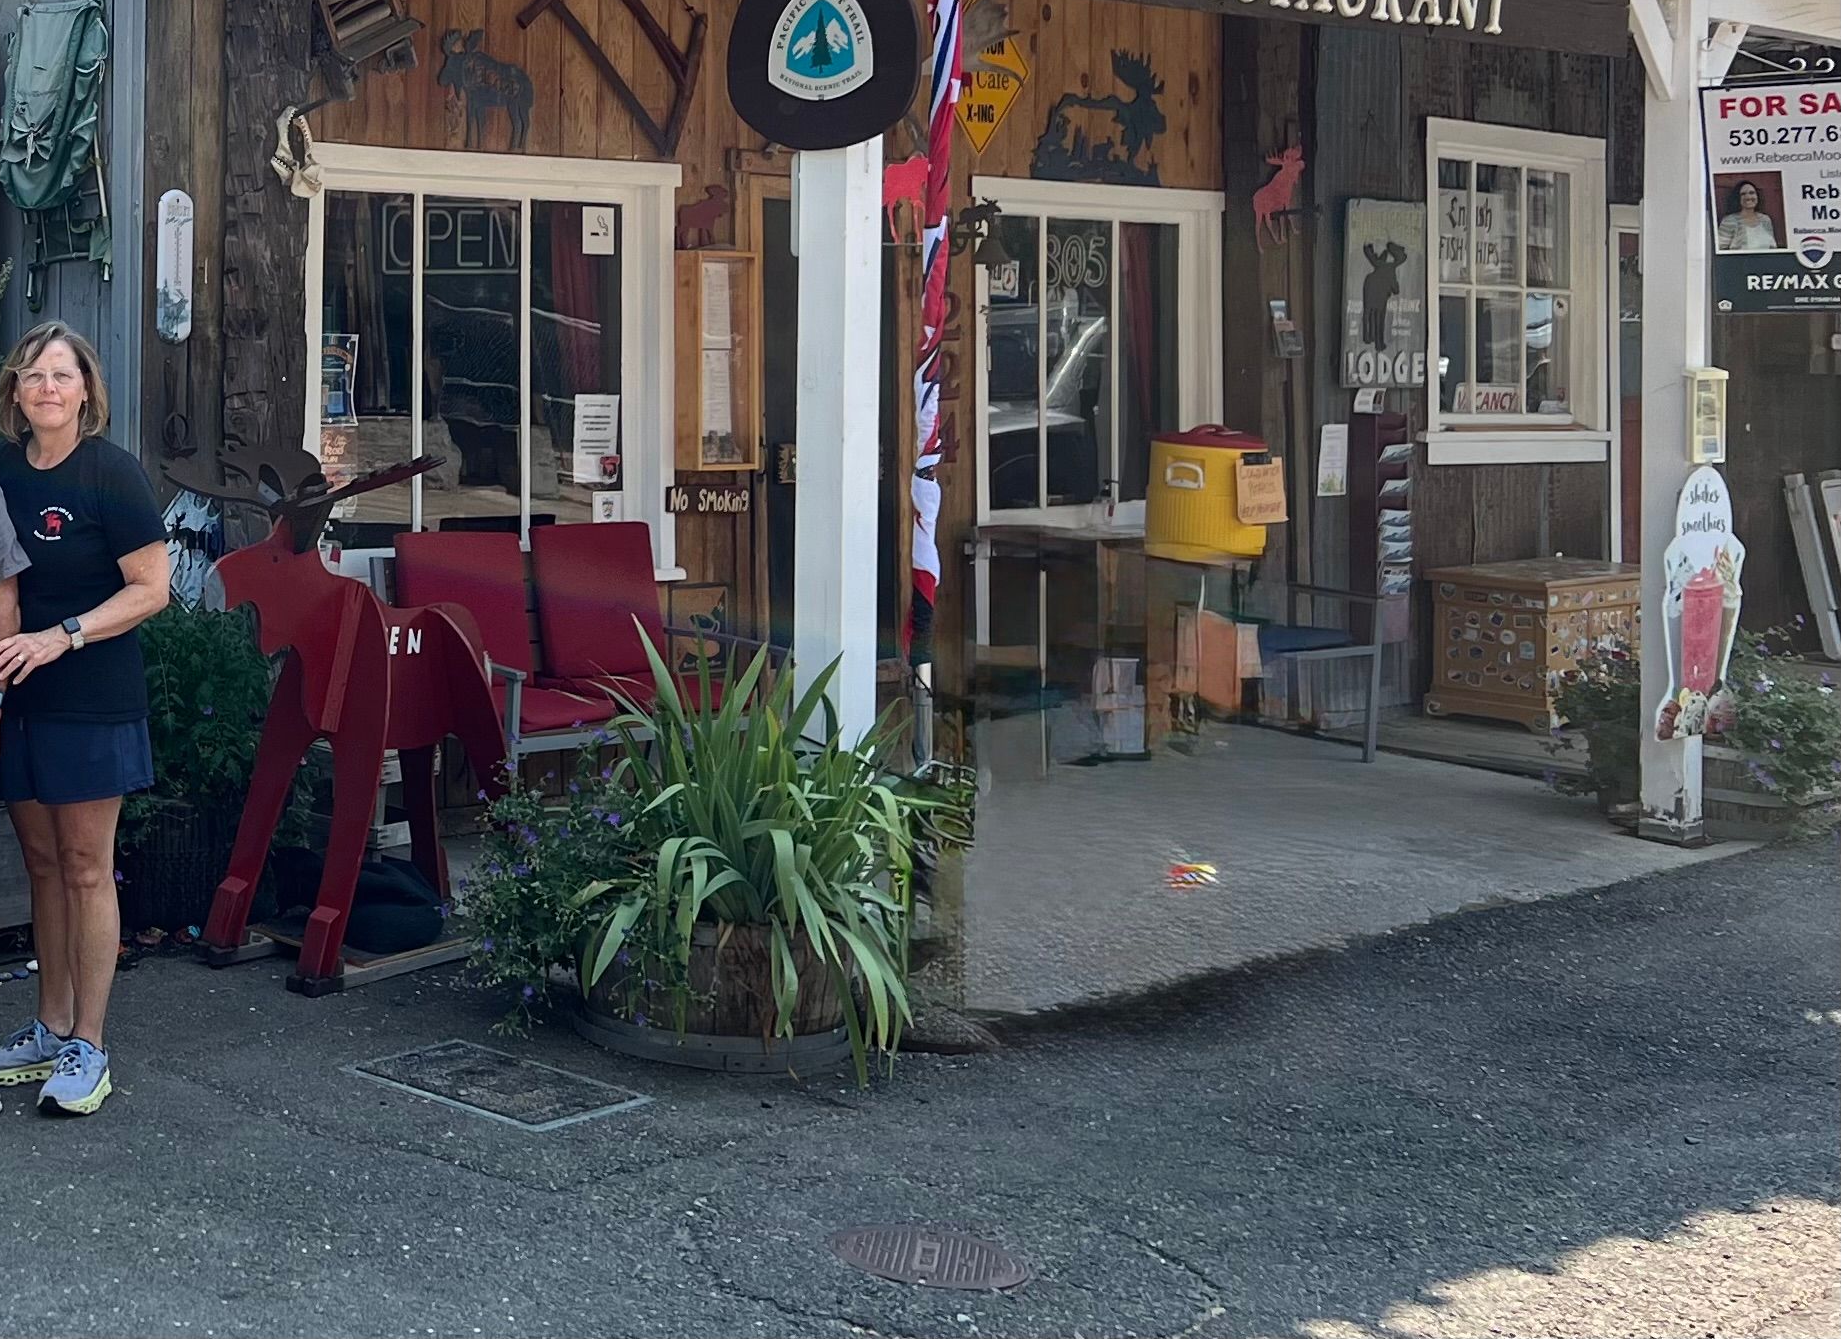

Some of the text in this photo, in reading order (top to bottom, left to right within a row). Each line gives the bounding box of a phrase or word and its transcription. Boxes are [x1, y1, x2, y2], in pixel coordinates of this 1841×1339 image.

[844, 4, 865, 45] TRAIL
[779, 70, 863, 91] NATIONAL SCENIC TRAIL
[966, 103, 995, 123] X-ING
[1719, 94, 1788, 119] FOR
[1729, 125, 1841, 147] 530.277.6
[389, 209, 517, 268] OPEN
[1747, 273, 1830, 291] RE/MAX
[1345, 350, 1425, 384] LODGE
[1457, 391, 1516, 411] VCANCY
[670, 487, 689, 513] No
[1689, 483, 1720, 505] shakes
[1681, 511, 1726, 536] smoothies
